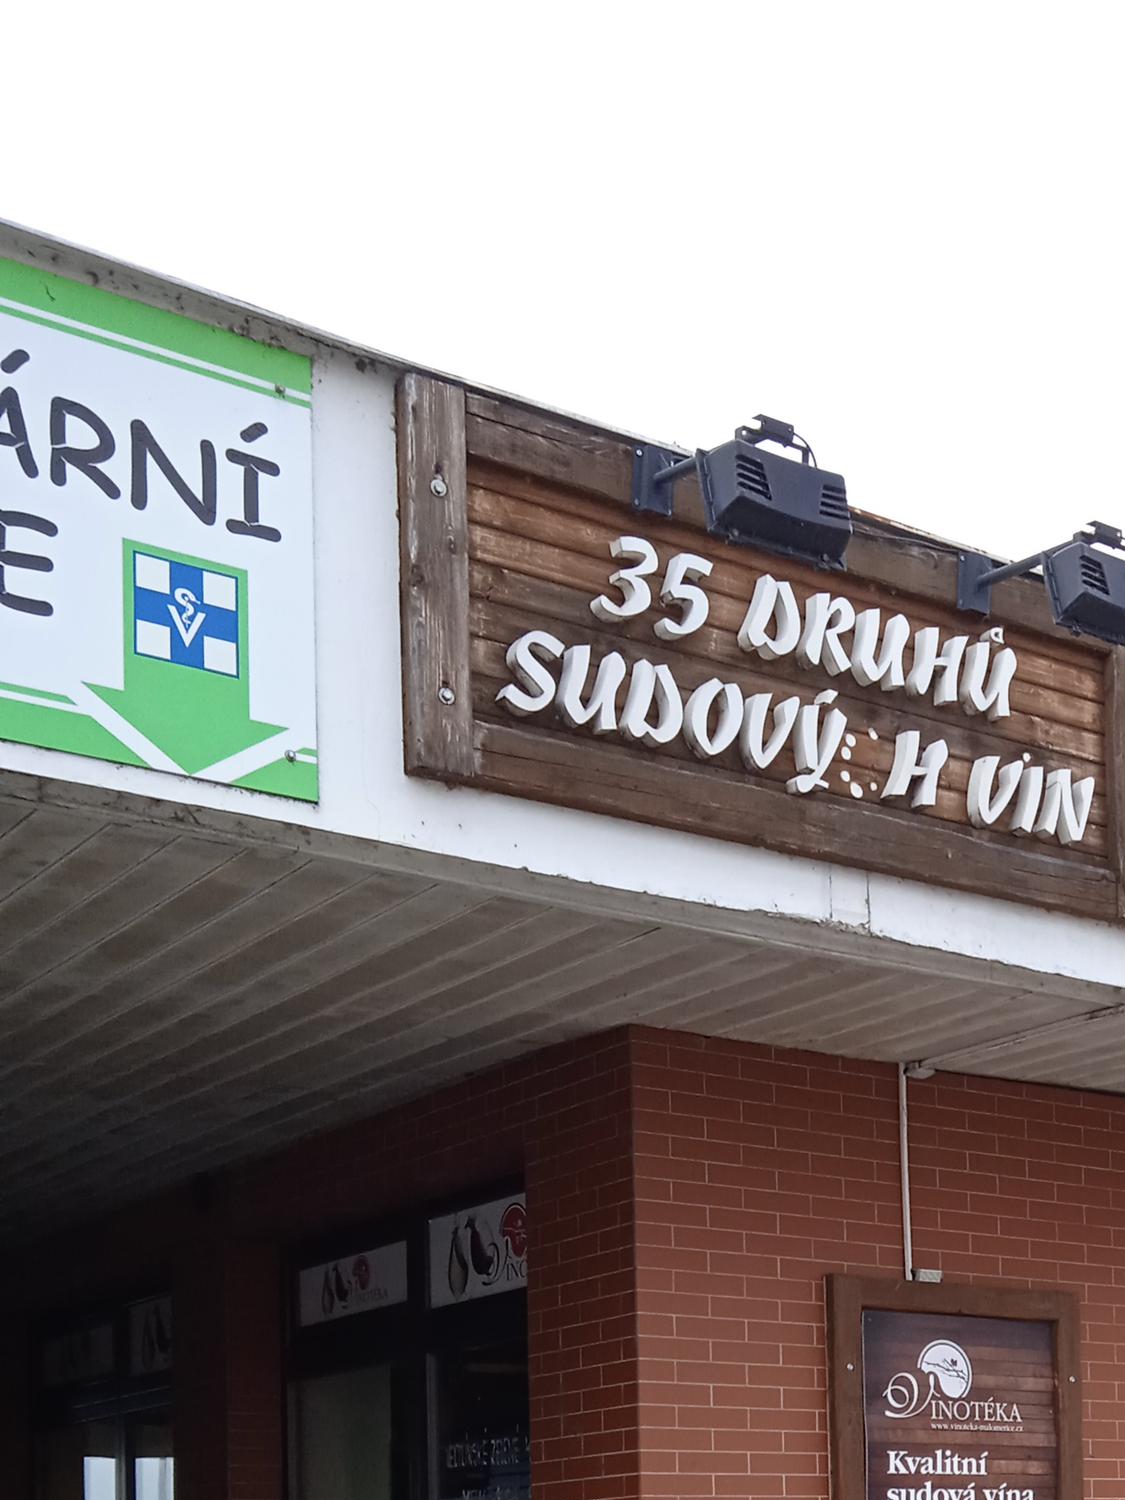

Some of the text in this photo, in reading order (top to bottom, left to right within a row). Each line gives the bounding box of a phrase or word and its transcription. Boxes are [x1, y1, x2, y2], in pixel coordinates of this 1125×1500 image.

[590, 535, 1018, 721] 35 DRUHŮ
[882, 1371, 1023, 1422] VINOTÉKA
[886, 1450, 989, 1476] Kvalitní
